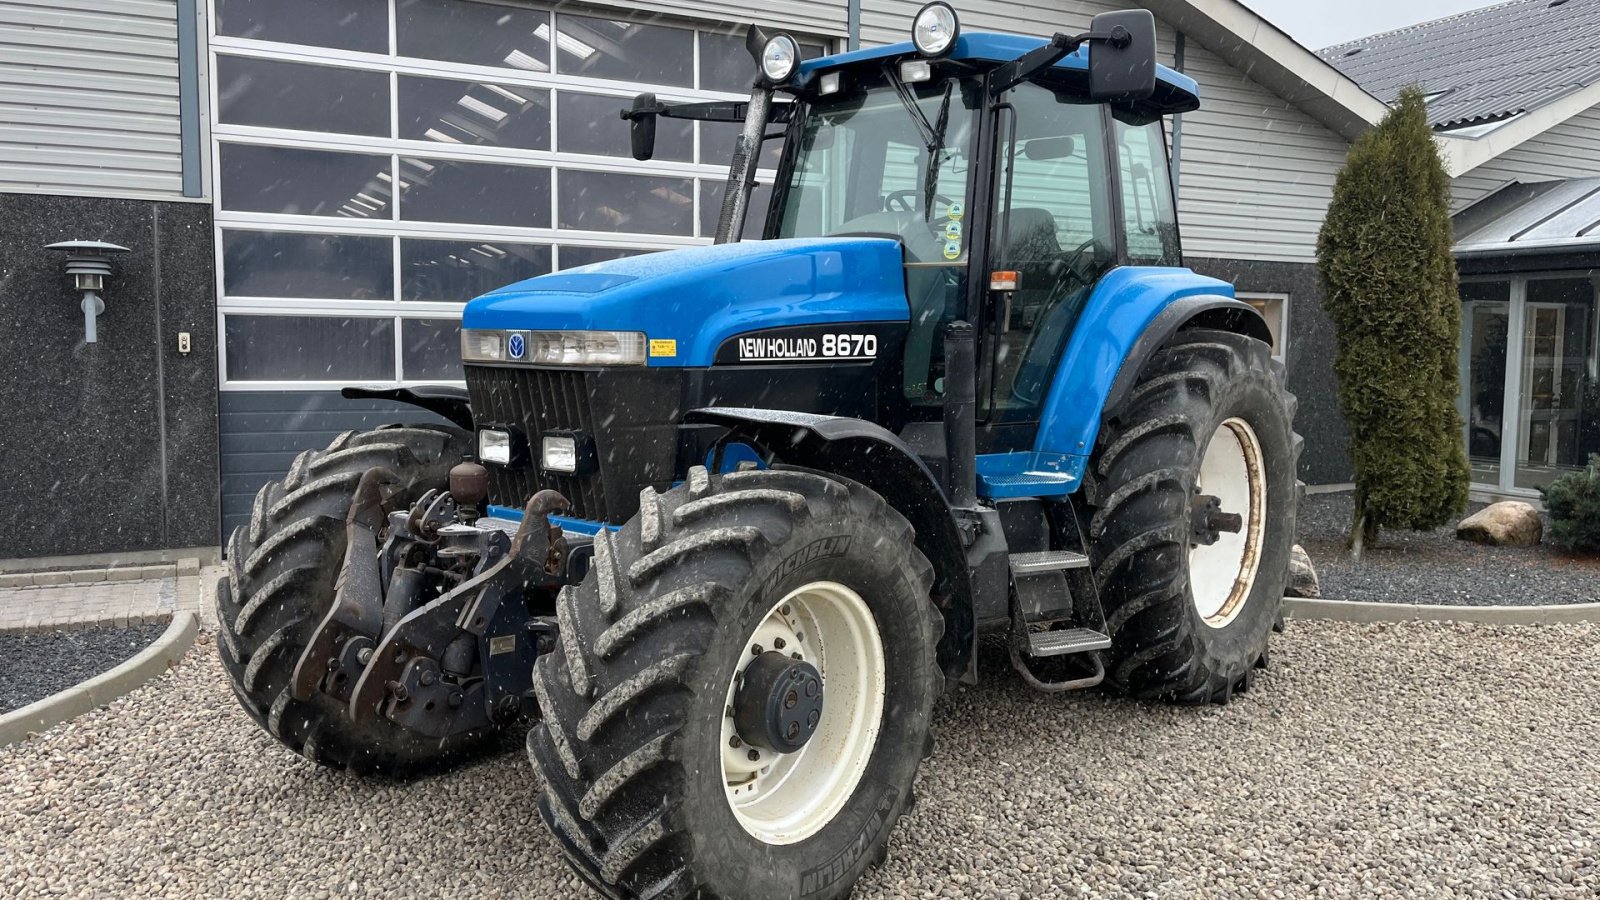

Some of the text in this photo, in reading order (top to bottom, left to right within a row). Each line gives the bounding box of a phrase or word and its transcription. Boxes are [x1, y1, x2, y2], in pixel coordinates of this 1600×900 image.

[739, 334, 878, 358] NEW HOLLAND 8670
[761, 535, 852, 601] MICHELIN
[801, 808, 882, 897] MICHELIN
